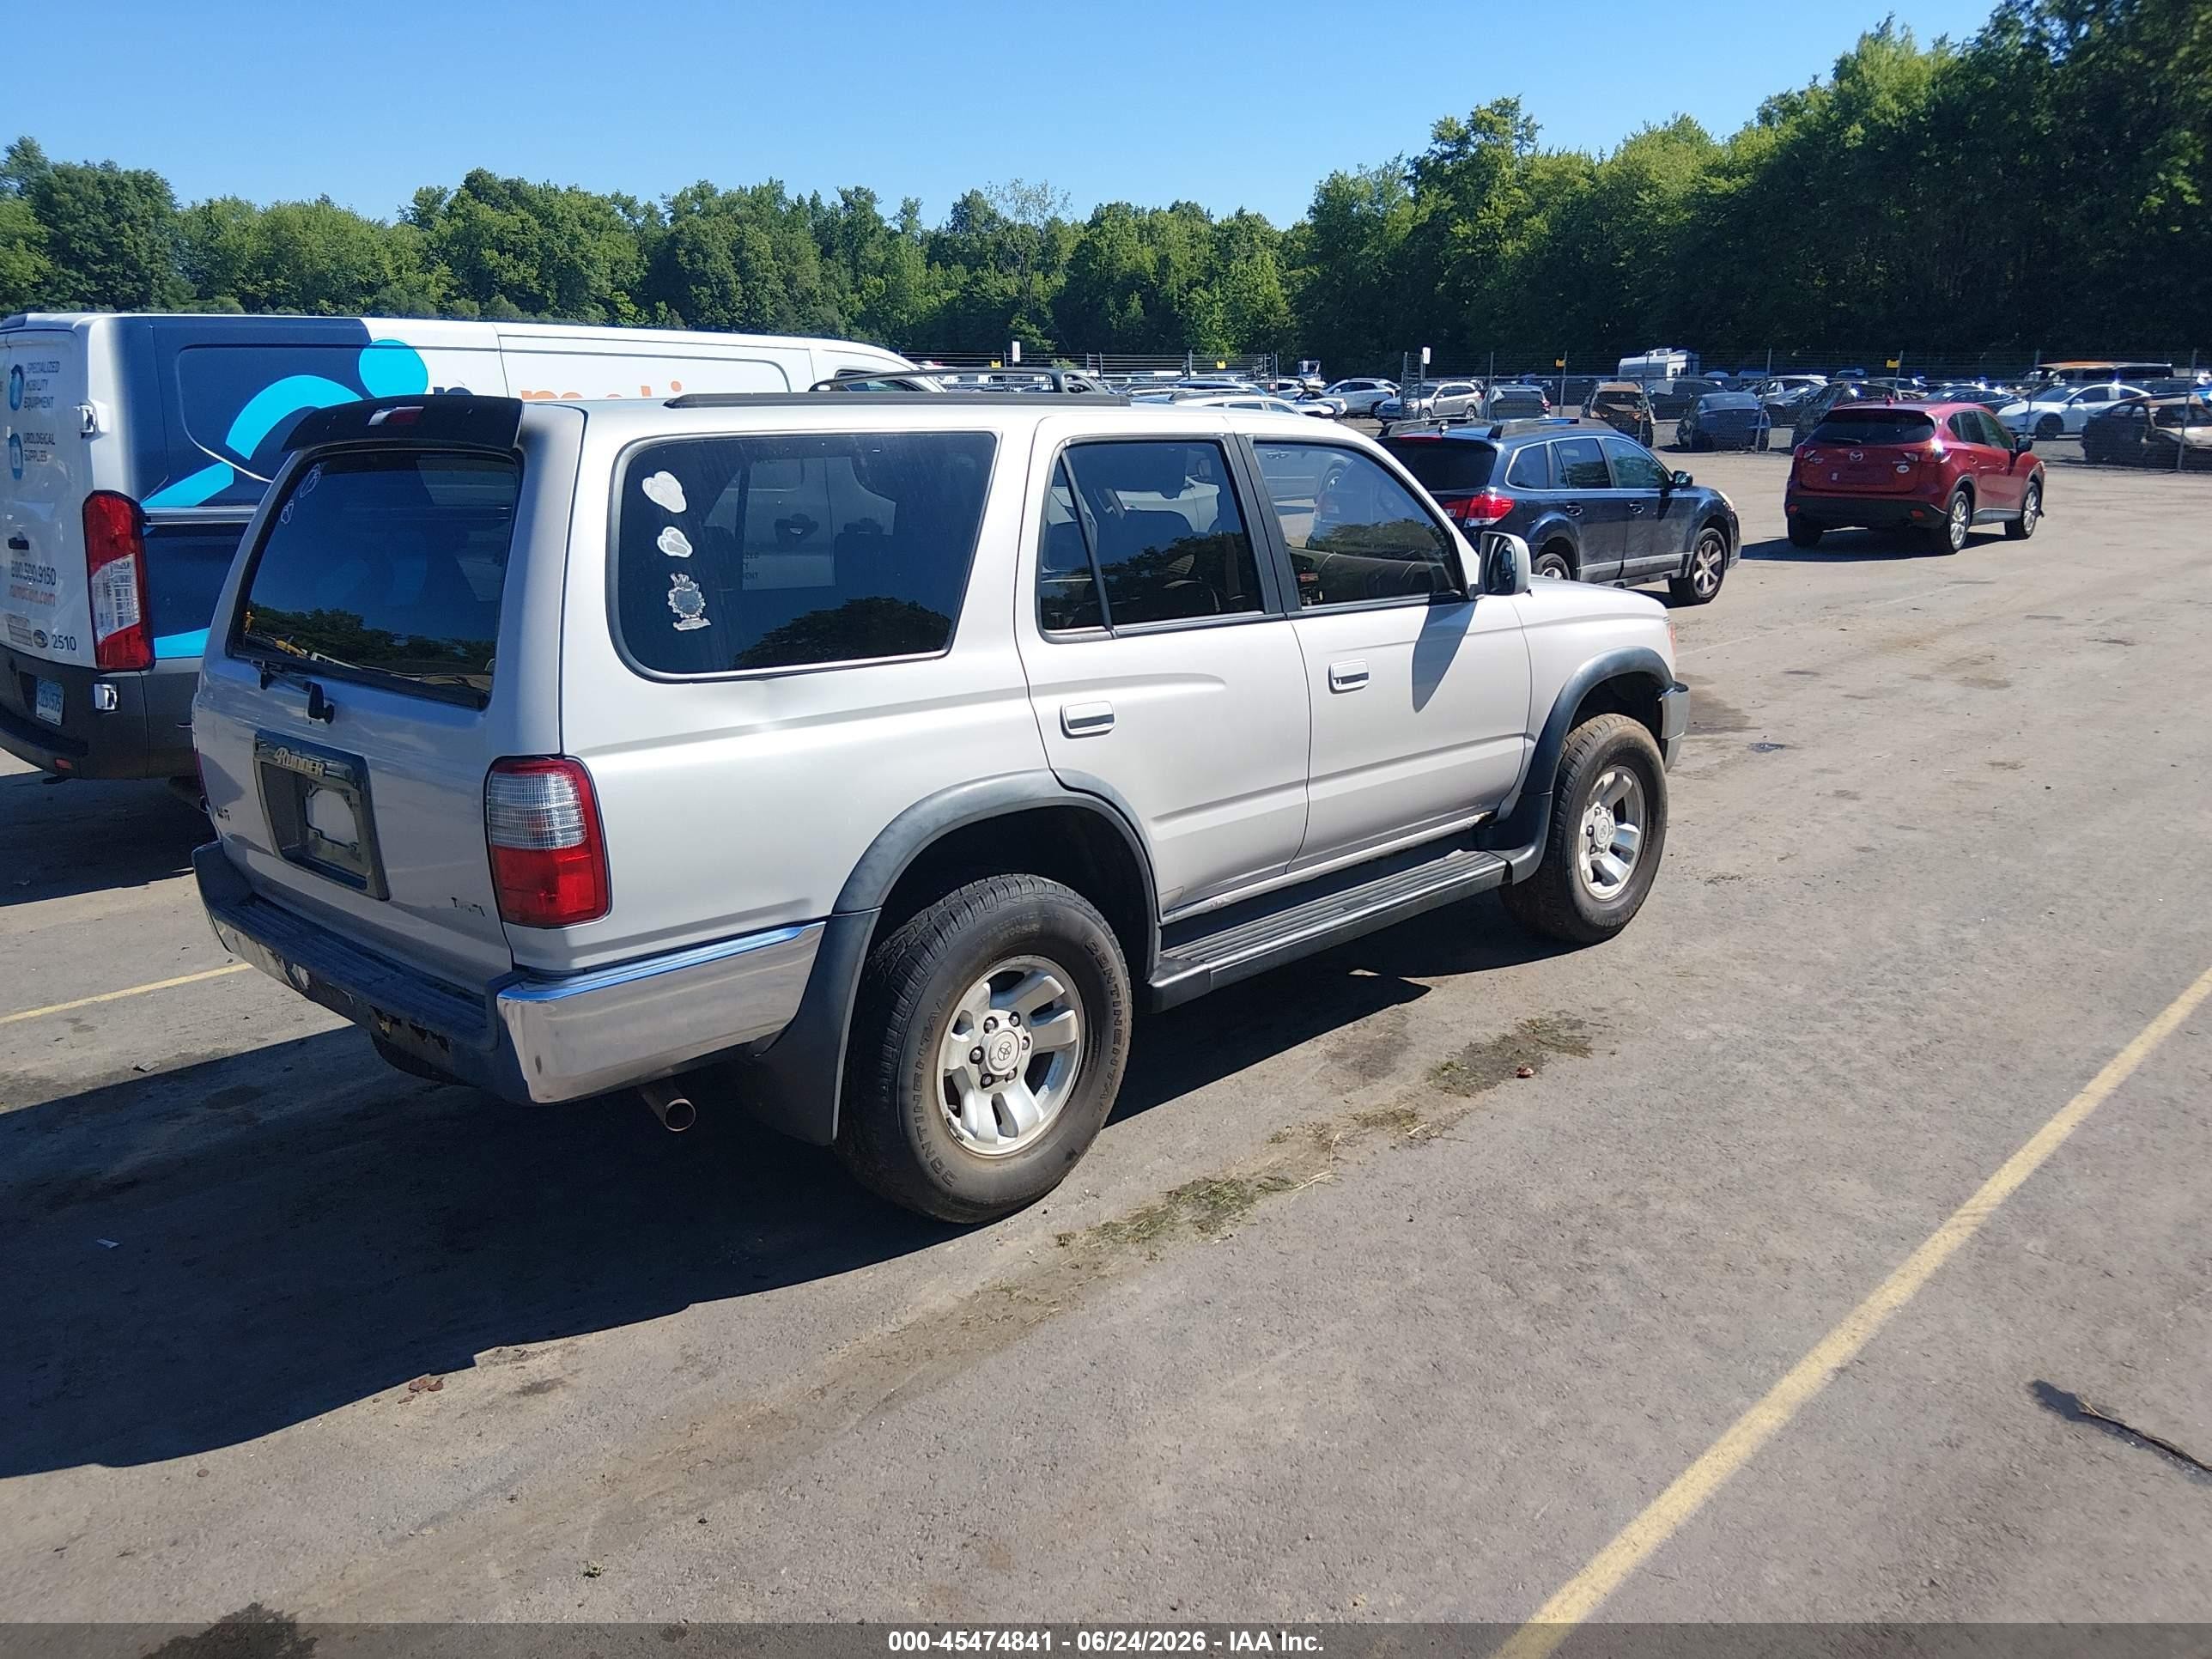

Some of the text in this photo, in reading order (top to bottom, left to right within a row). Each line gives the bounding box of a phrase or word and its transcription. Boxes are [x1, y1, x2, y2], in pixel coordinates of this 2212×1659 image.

[27, 361, 60, 374] SPECIALIZED
[23, 396, 54, 410] EQUIPMENT
[52, 635, 76, 651] 2510
